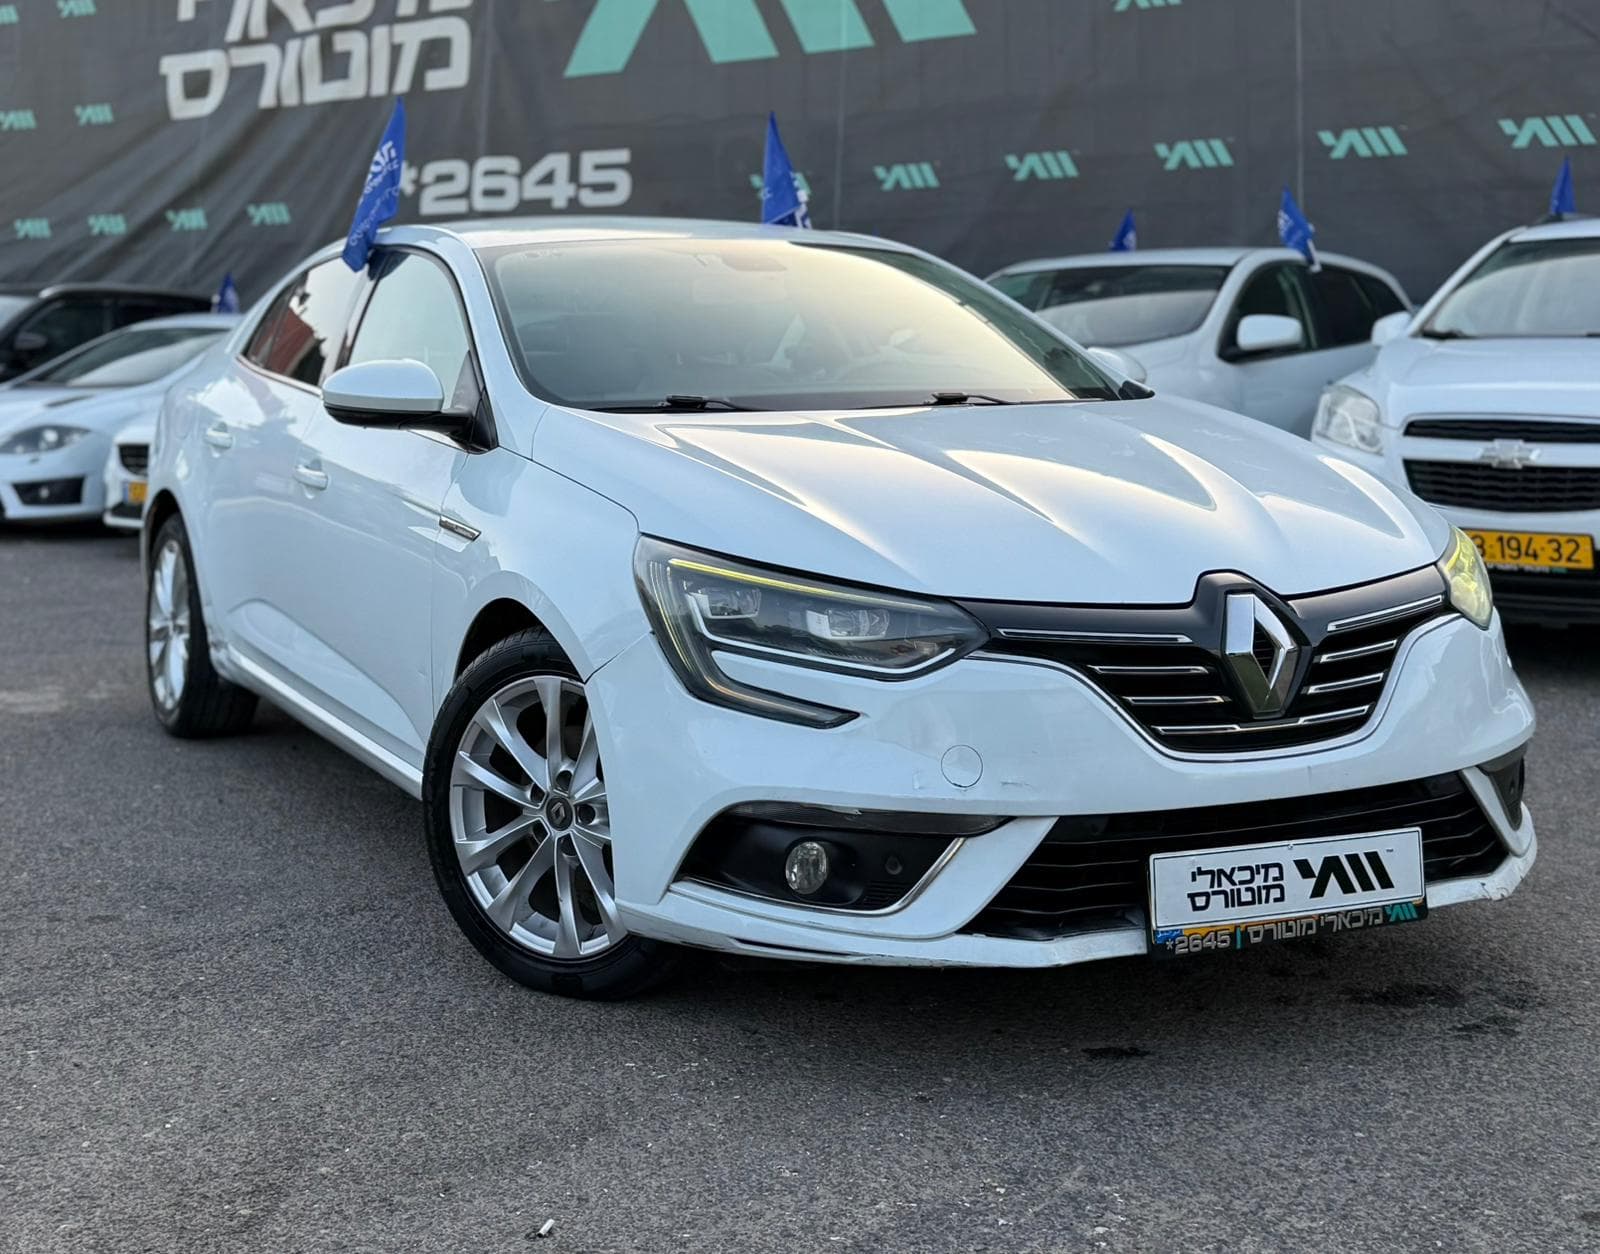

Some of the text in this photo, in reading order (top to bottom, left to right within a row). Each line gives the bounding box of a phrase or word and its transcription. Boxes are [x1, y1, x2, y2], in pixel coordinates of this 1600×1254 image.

[159, 16, 470, 120] מוטורס
[1191, 862, 1284, 889] מיכאלי
[1187, 883, 1286, 912] מוטורס
[1247, 917, 1318, 944] מוטורס
[1320, 905, 1384, 933] מיכאלי
